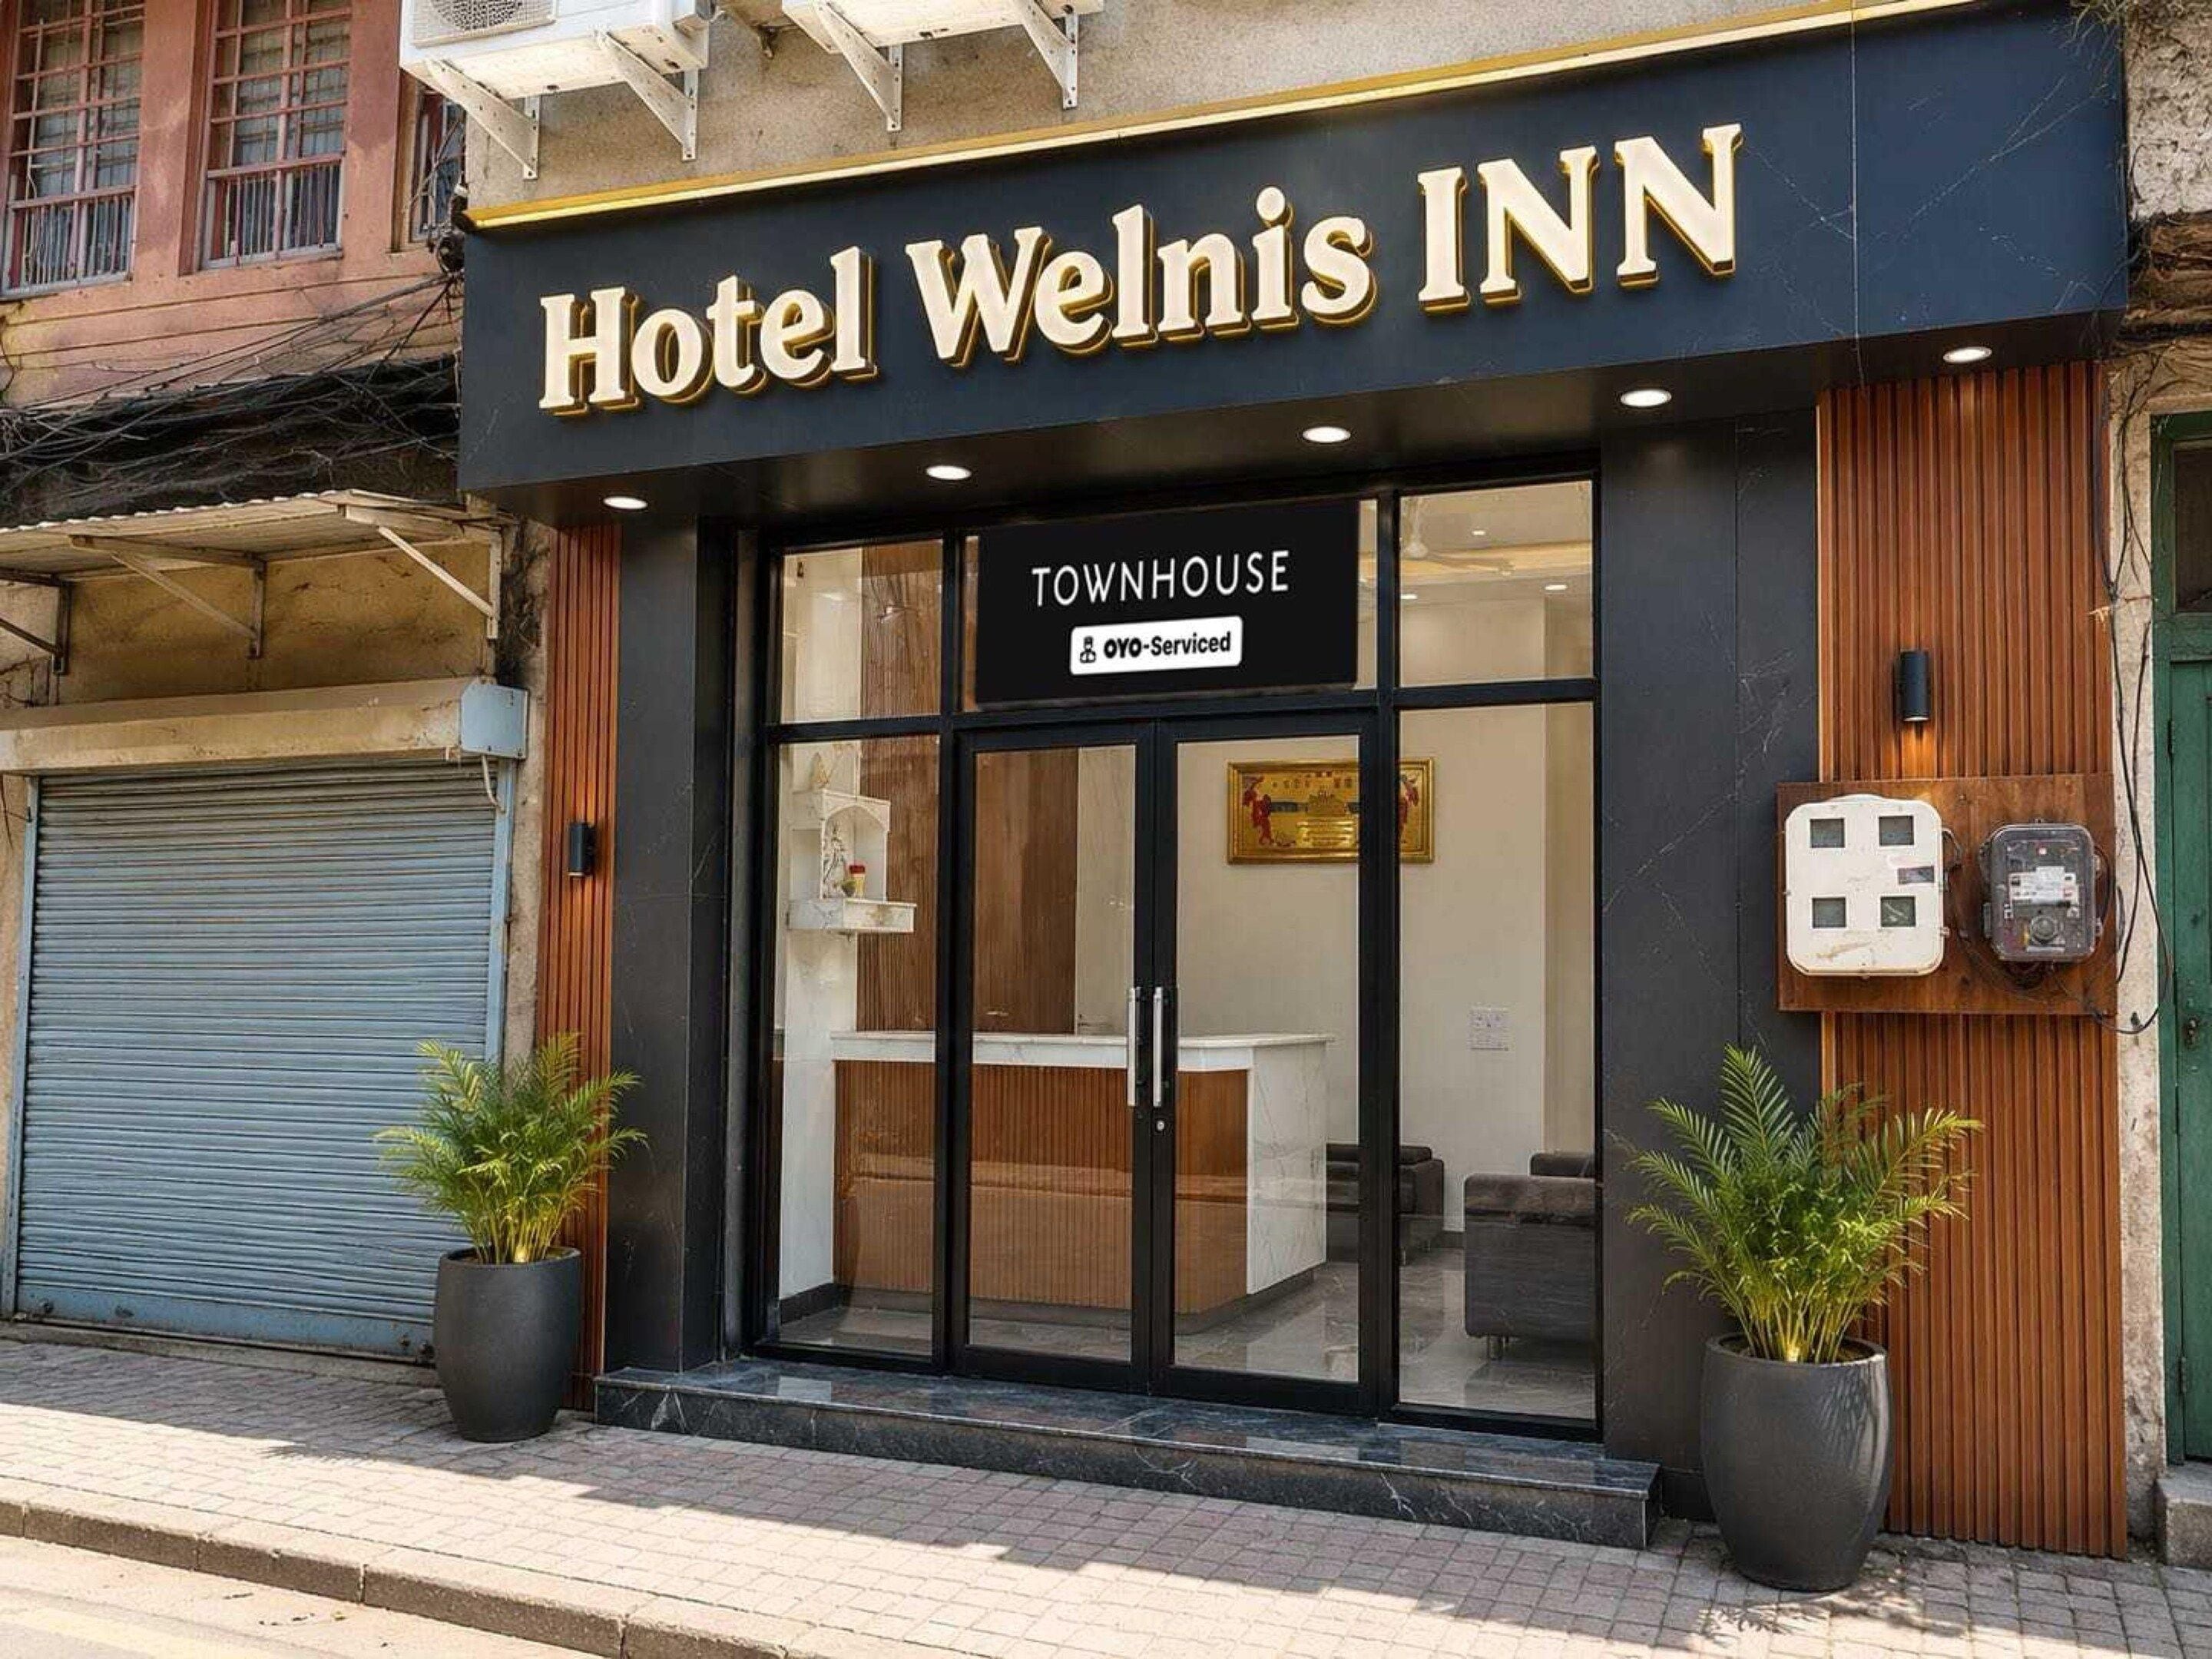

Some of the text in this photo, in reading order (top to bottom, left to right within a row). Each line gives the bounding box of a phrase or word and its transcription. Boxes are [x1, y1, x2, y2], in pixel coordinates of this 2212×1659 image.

[538, 122, 1743, 417] Hotel Welnis INN
[1031, 549, 1290, 607] TOWNHOUSE
[1104, 631, 1231, 659] OYO-Serviced
